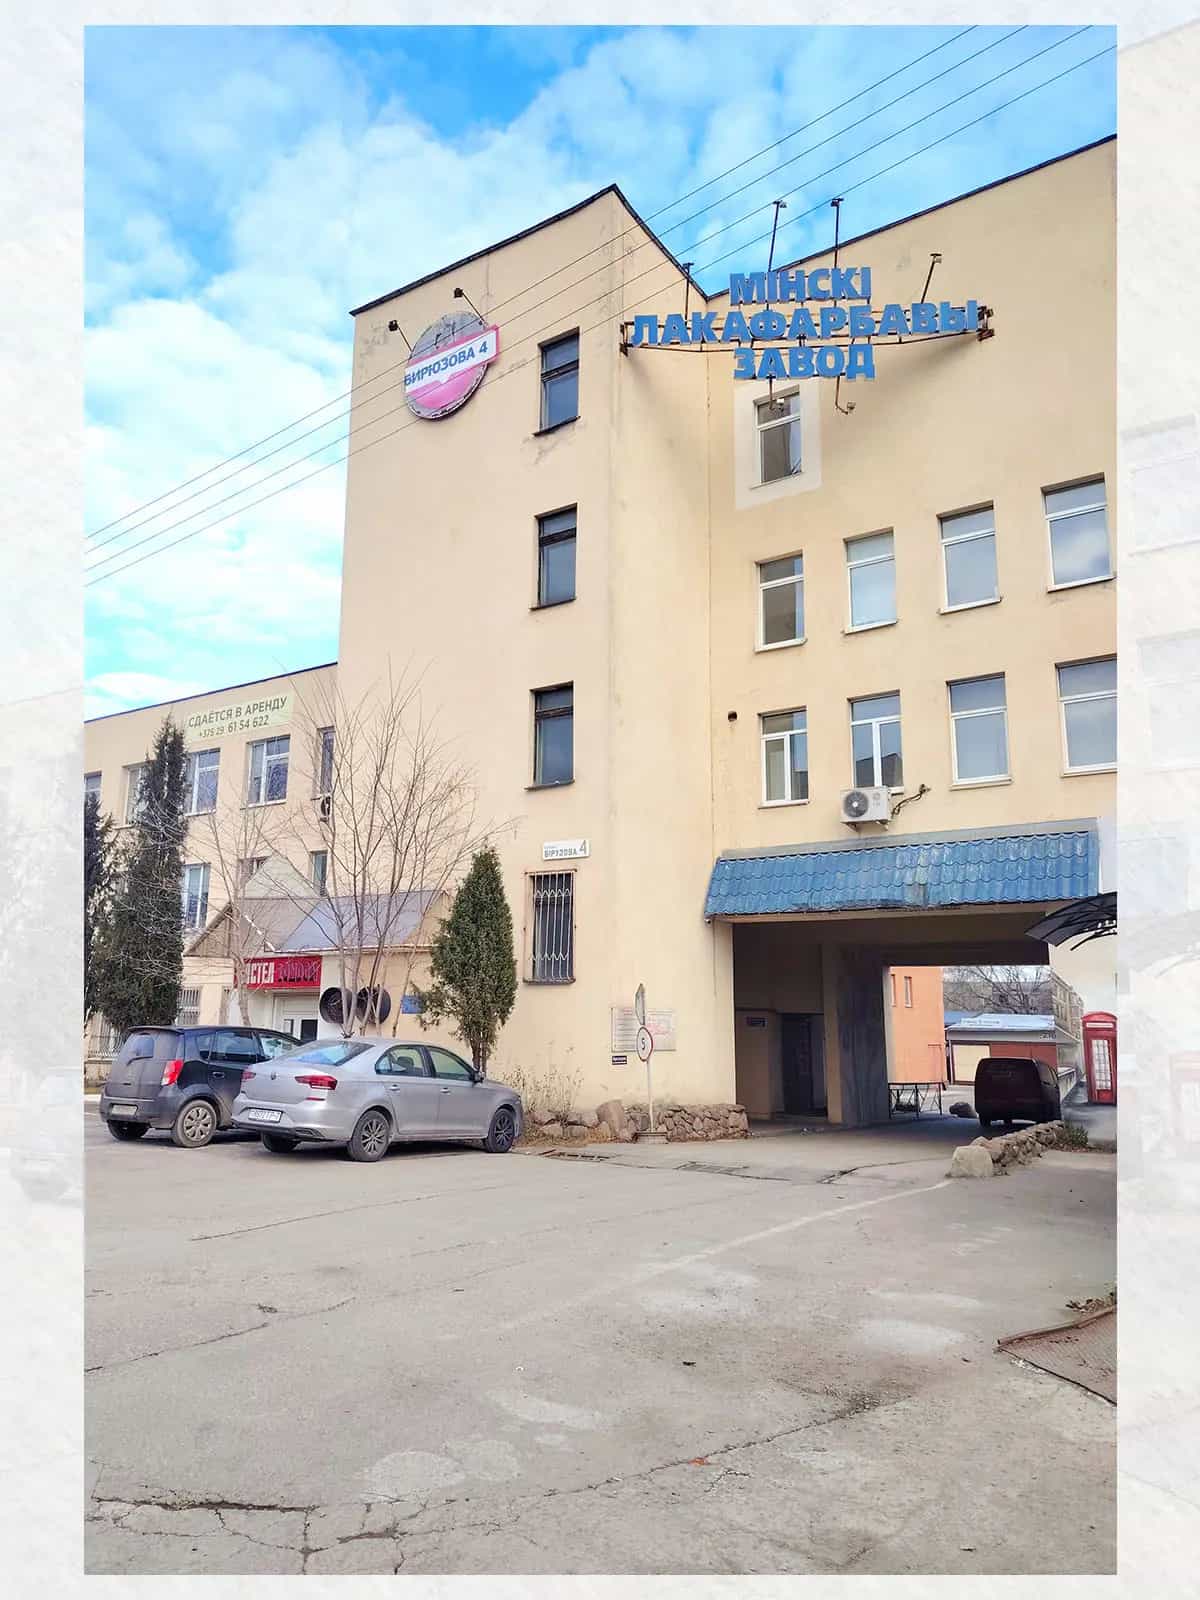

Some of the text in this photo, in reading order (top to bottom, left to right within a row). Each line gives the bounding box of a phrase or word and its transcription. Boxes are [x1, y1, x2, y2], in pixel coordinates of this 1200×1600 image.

[730, 266, 872, 306] МІНСКІ
[631, 300, 979, 347] ЛАКАФАРБАВЫ
[404, 341, 488, 386] БИРЮЗОВА 4
[734, 343, 875, 380] ЗАВОД
[228, 721, 238, 733] 61
[239, 718, 250, 730] 54
[252, 714, 270, 728] 622
[235, 706, 242, 717] В
[245, 696, 288, 716] АРЕНДУ
[579, 839, 587, 855] 4
